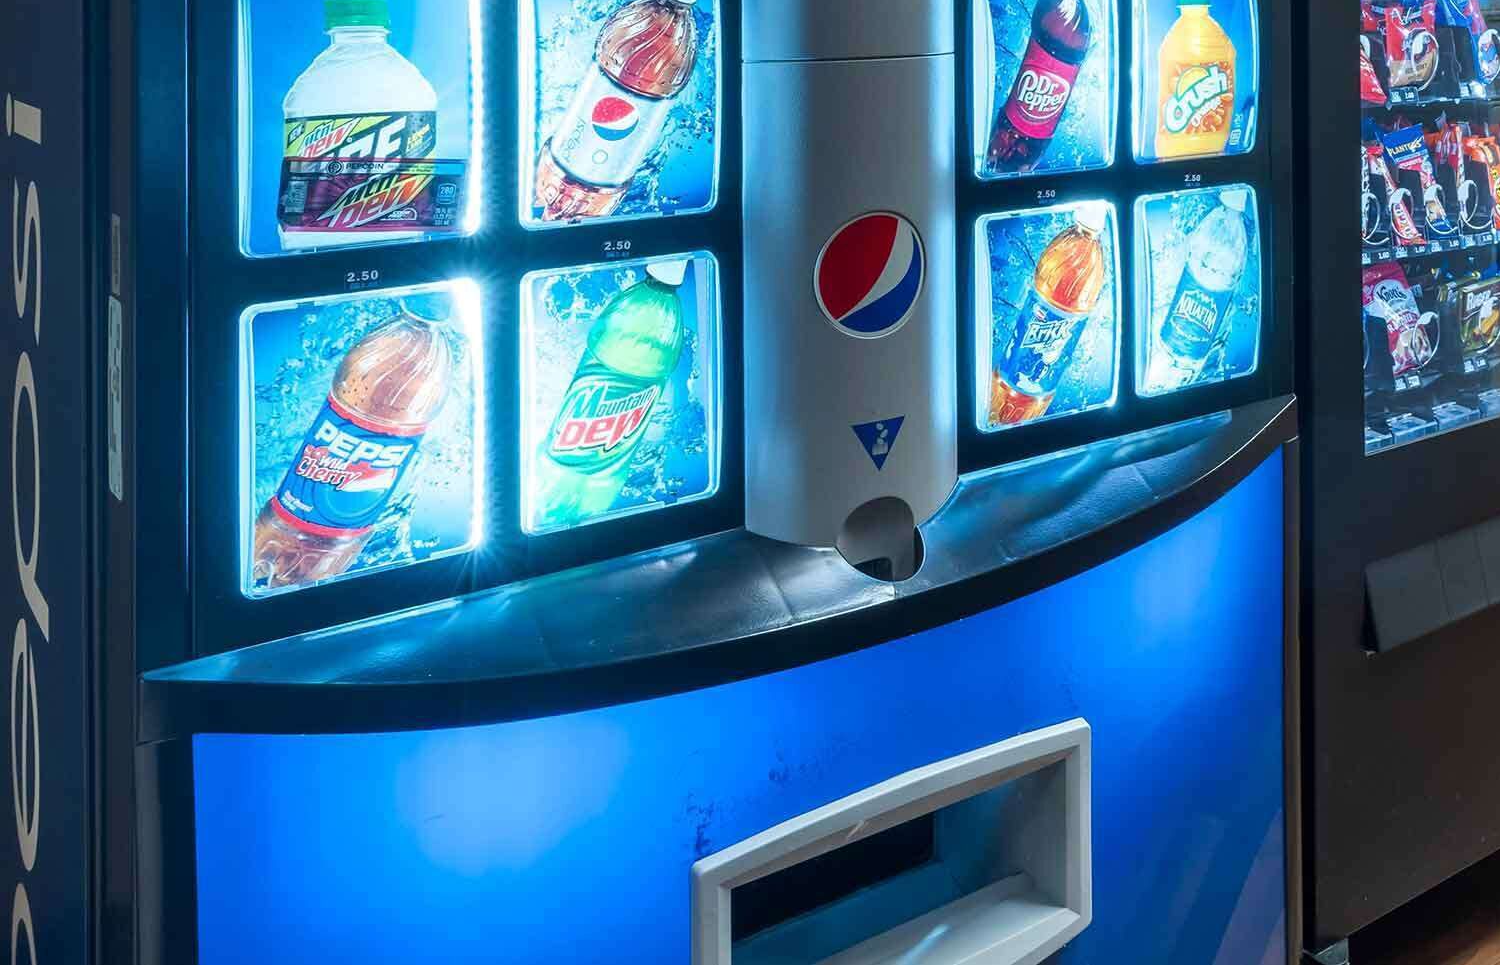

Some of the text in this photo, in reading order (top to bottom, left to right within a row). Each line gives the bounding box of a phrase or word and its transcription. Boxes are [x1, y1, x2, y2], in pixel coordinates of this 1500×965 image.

[1018, 70, 1067, 112] Pepper
[1037, 75, 1059, 95] Dr
[1166, 64, 1228, 133] Crush
[345, 163, 384, 171] PEPCOIN
[1184, 174, 1201, 182] 2.50
[1037, 190, 1056, 198] 2.50
[604, 240, 631, 251] 2.50
[346, 270, 379, 283] 2.50
[559, 382, 658, 421] Mountain
[314, 419, 414, 468] PEPSI
[296, 457, 362, 490] Cherry
